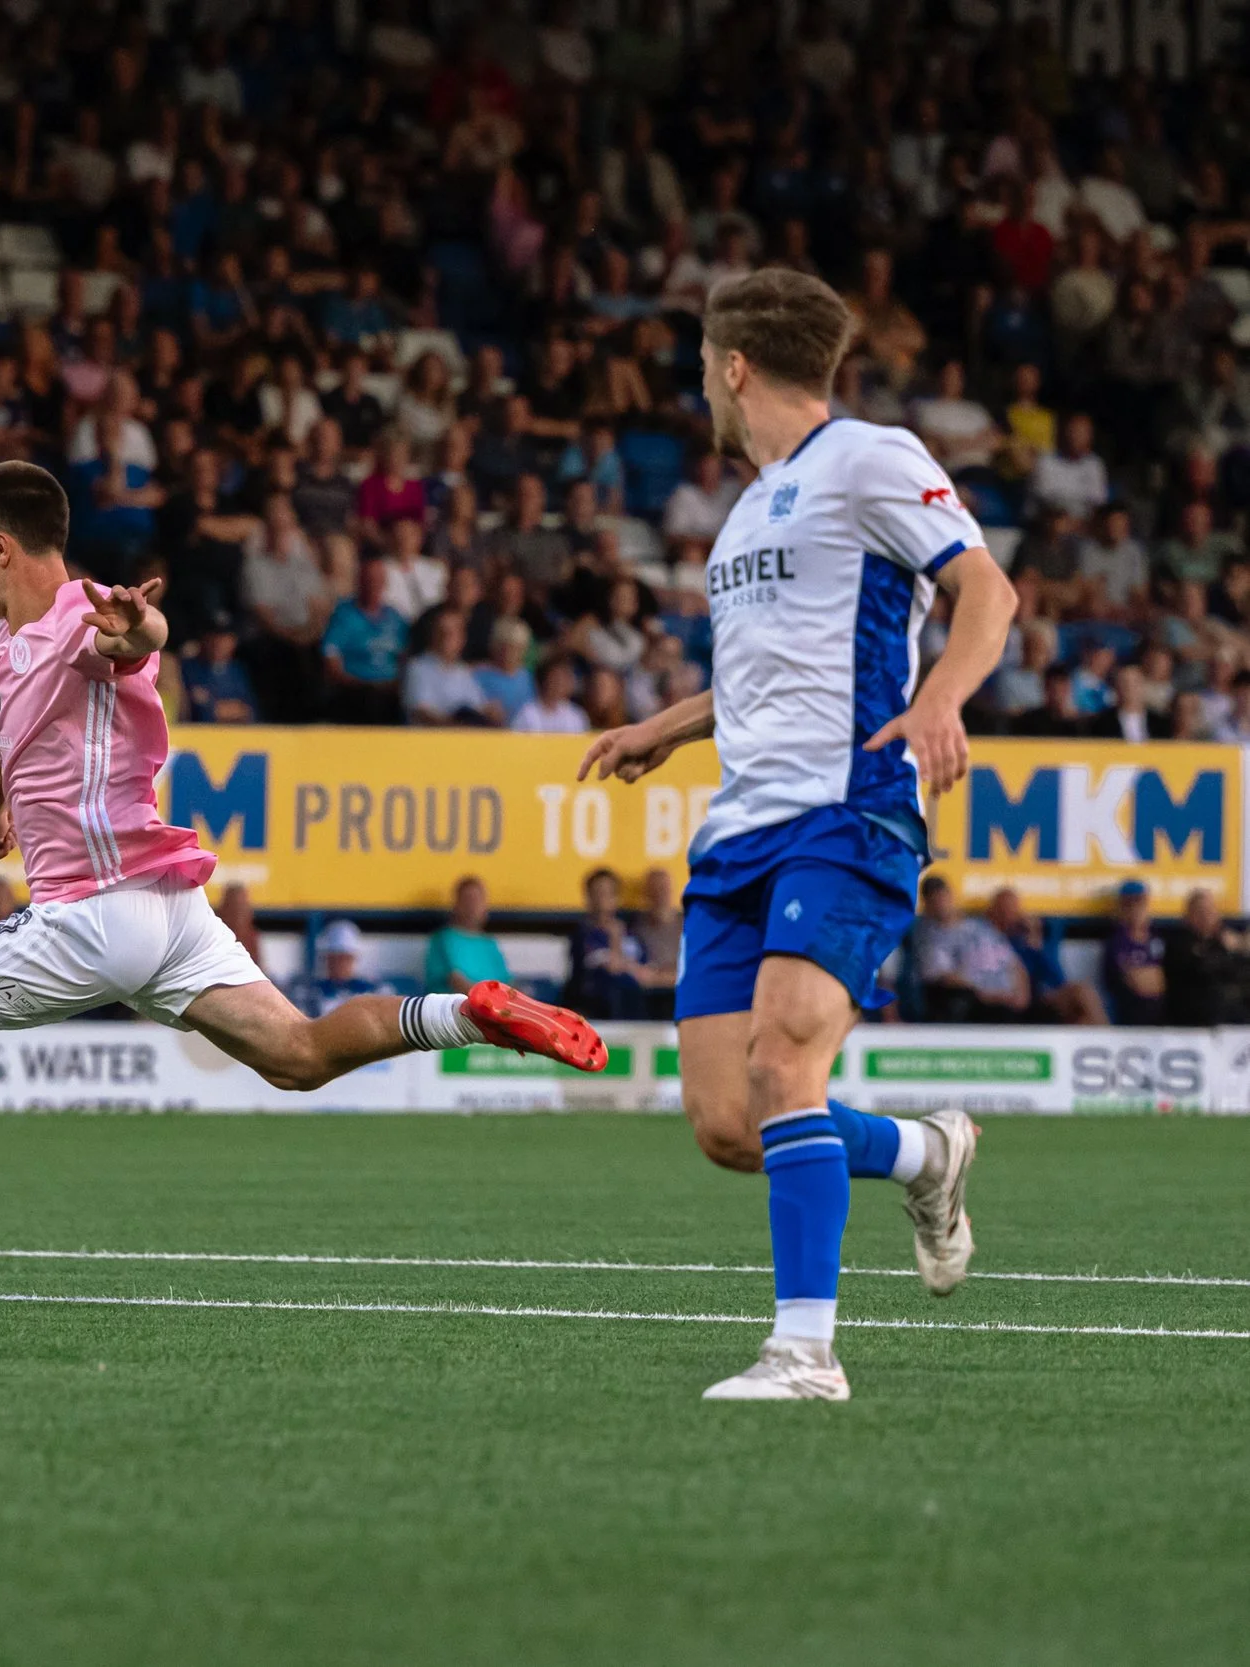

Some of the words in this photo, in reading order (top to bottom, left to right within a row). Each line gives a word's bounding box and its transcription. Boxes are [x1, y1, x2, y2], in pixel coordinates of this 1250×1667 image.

[294, 783, 502, 853] PROUD
[537, 785, 610, 857] TO
[968, 763, 1225, 865] MKM
[19, 1045, 158, 1084] WATER
[1072, 1045, 1202, 1096] S&S
